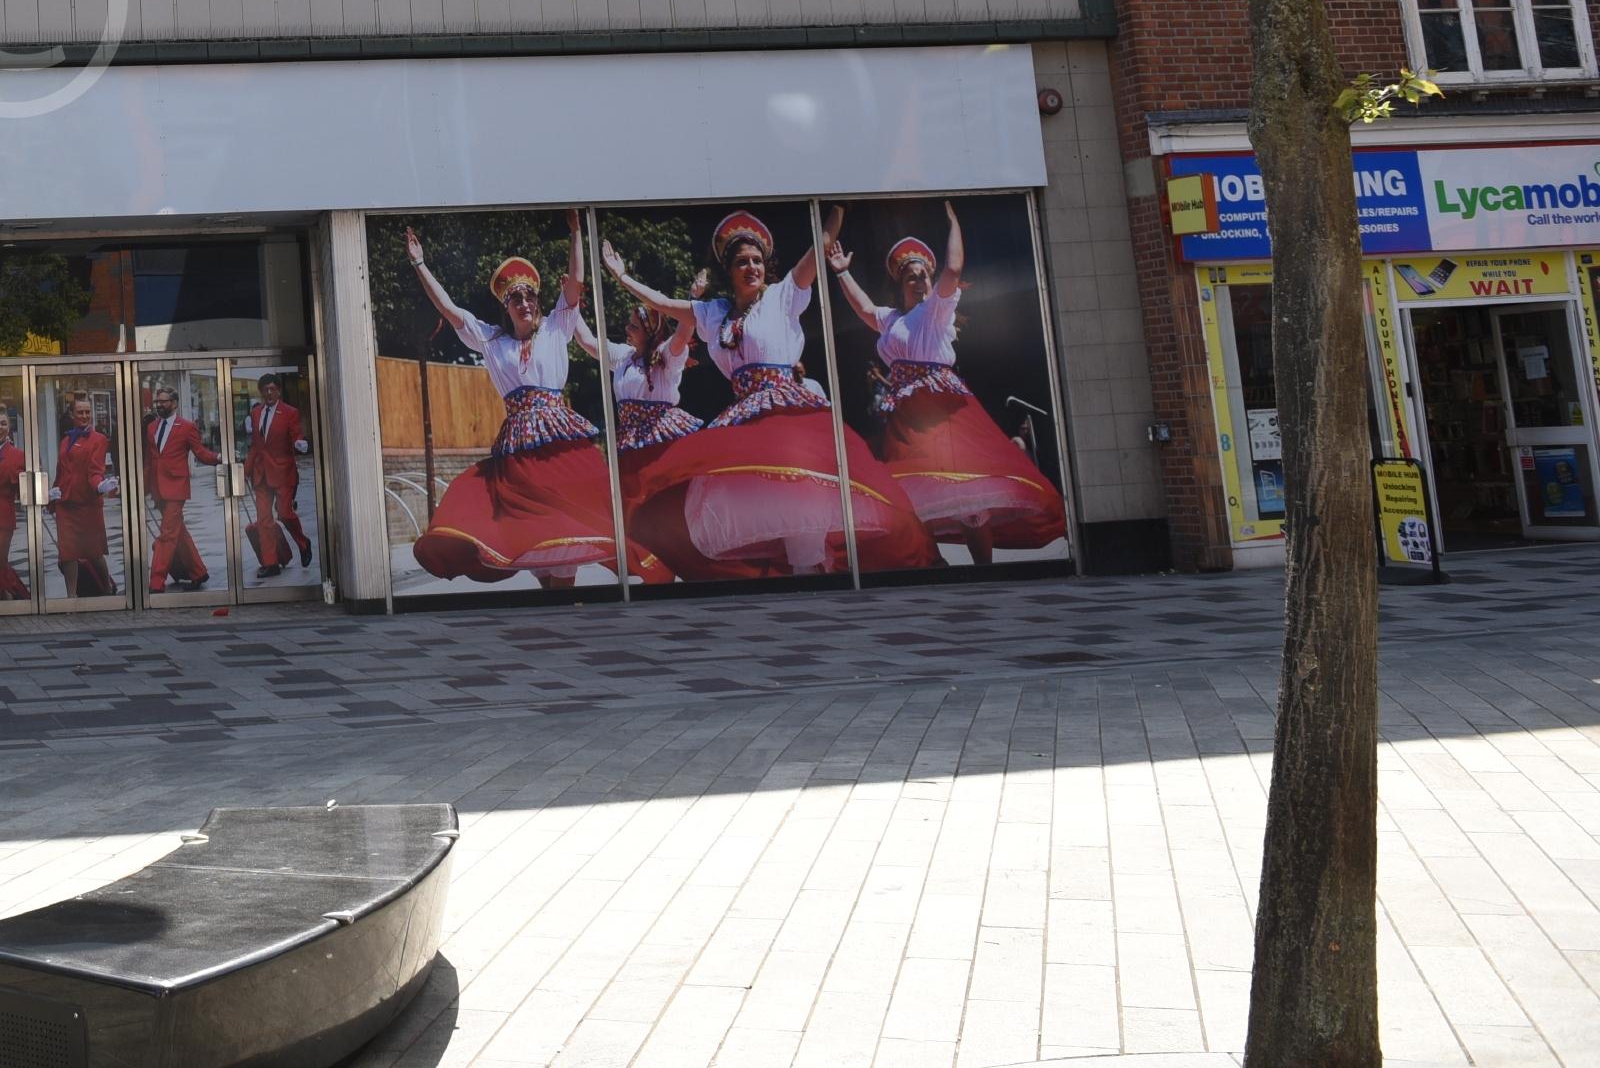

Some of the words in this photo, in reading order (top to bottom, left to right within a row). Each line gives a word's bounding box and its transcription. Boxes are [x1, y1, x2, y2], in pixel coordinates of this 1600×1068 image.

[1434, 175, 1600, 220] Lycamob
[1219, 212, 1268, 222] COMPUTE
[1357, 206, 1419, 218] LES/REPAIRS
[1527, 213, 1551, 226] Call
[1552, 213, 1573, 225] the
[1490, 259, 1508, 267] YOUR
[1509, 258, 1532, 266] PHONE
[1469, 278, 1534, 295] WAIT
[1377, 470, 1402, 479] MOBILE
[1403, 470, 1419, 479] HUB
[1383, 483, 1416, 492] Unlocking
[1385, 494, 1418, 505] Repairing
[1383, 506, 1424, 516] Accessories
